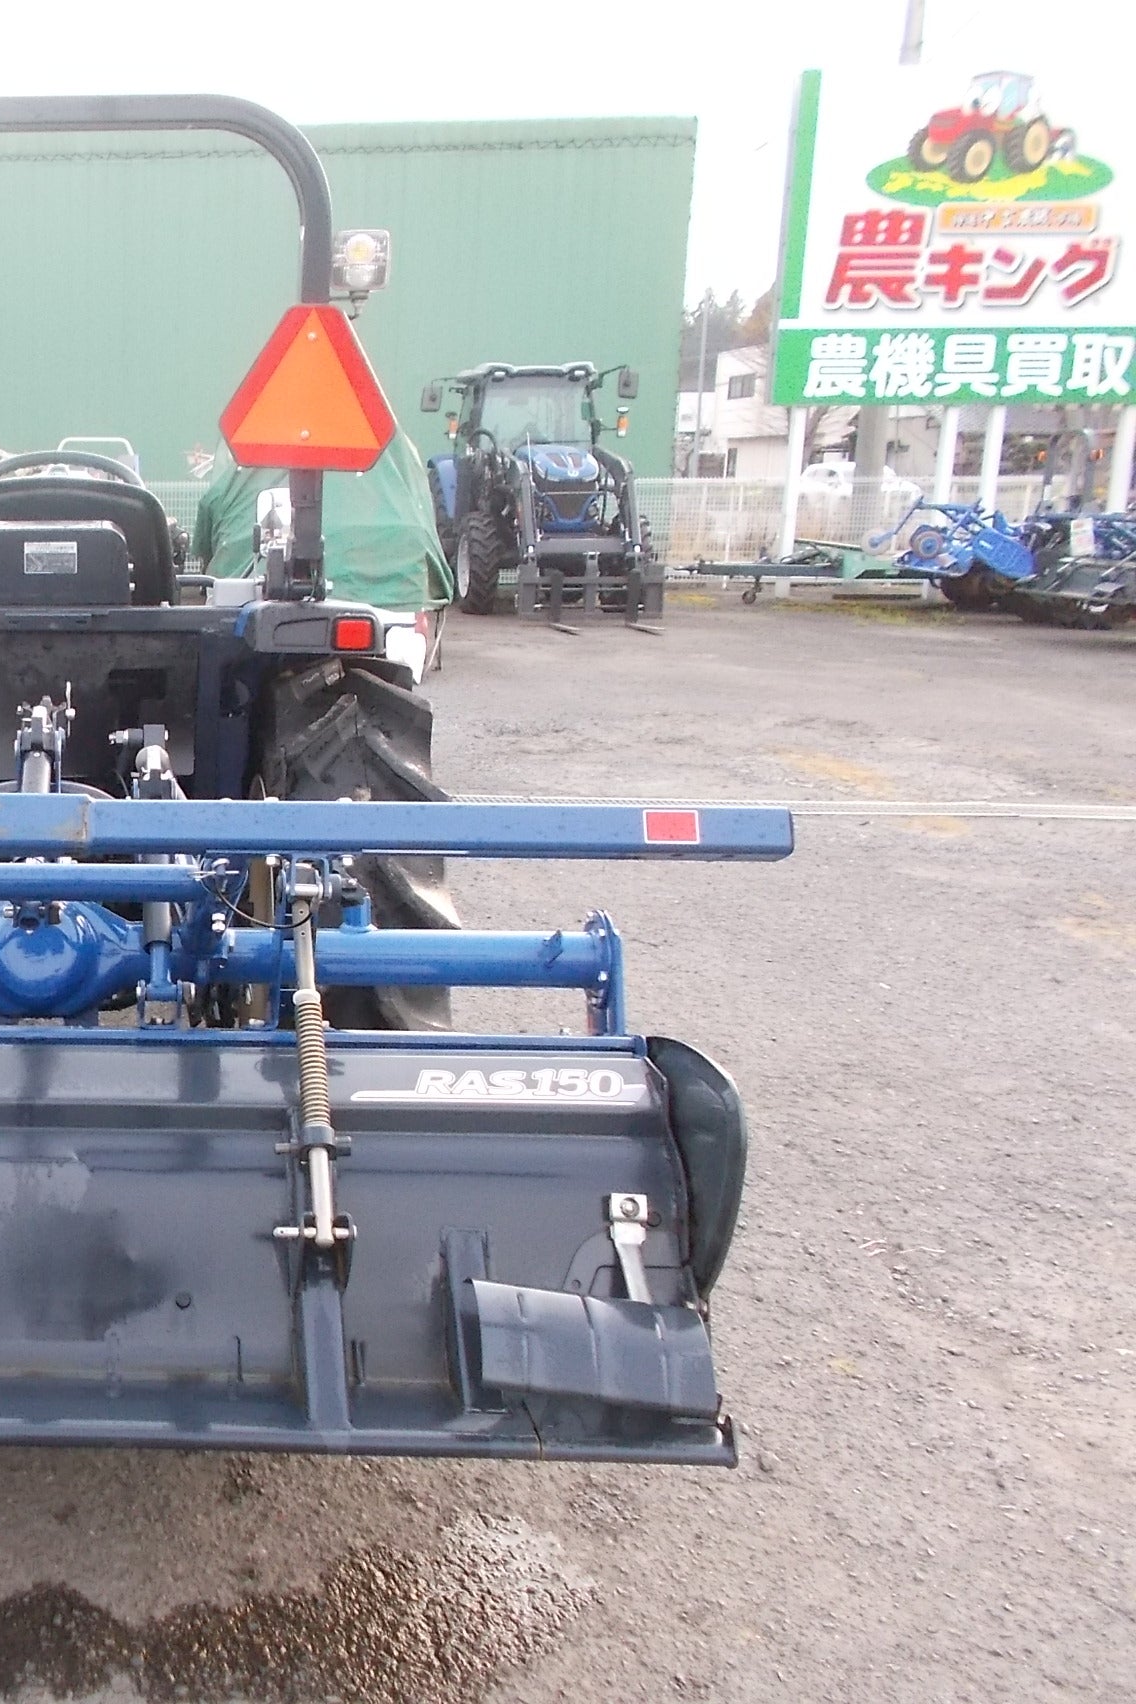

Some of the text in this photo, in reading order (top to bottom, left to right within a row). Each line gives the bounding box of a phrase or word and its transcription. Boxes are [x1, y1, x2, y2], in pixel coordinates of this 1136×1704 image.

[823, 208, 1120, 310] 農キング
[803, 333, 1134, 397] 農機具買取
[416, 1068, 624, 1097] RAS150
